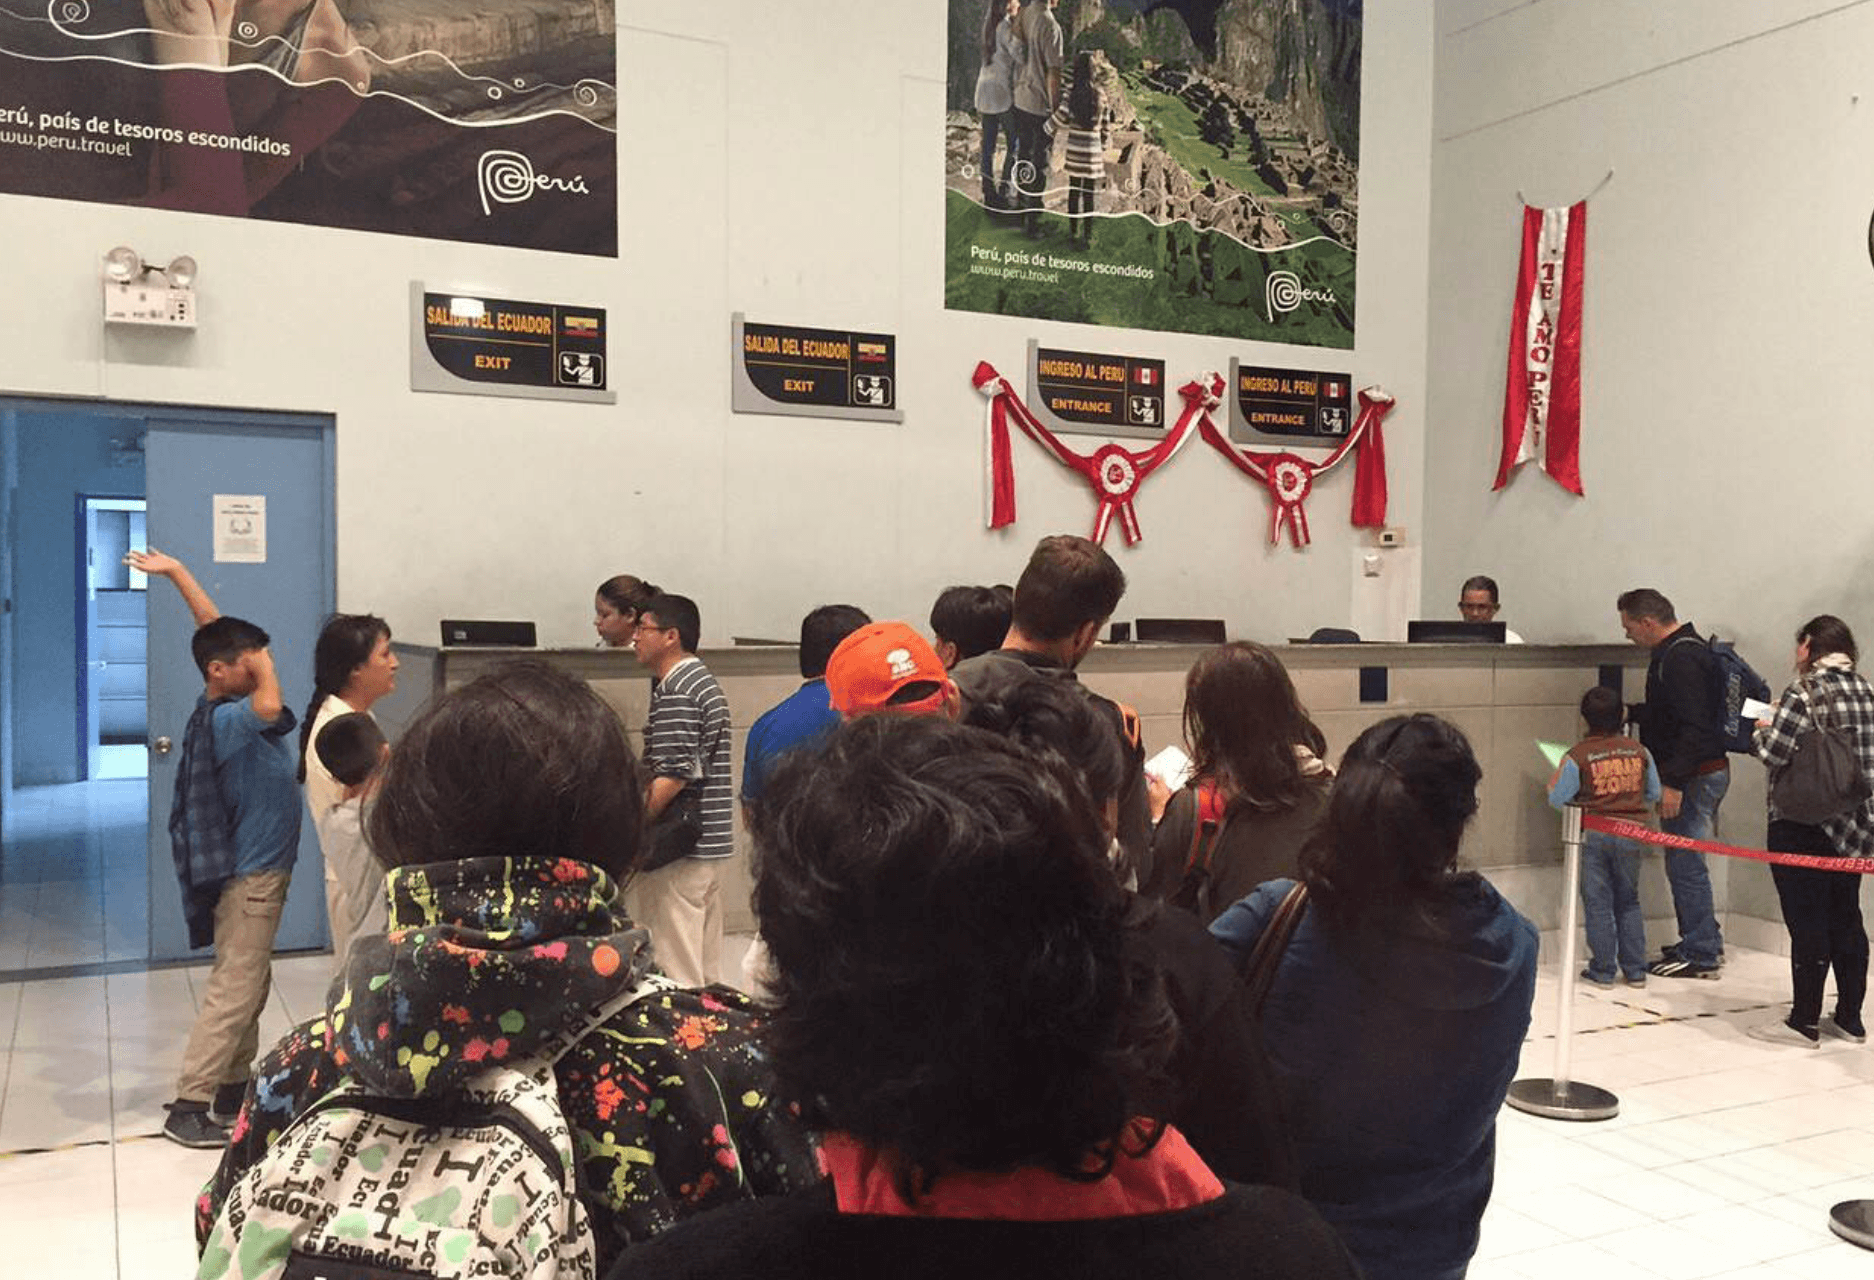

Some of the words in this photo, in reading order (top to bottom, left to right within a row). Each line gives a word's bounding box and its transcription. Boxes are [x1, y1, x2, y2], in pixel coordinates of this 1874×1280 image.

[39, 111, 80, 131] país
[86, 116, 109, 134] de
[114, 118, 183, 143] tesoros
[188, 131, 291, 156] escondidos
[971, 245, 1001, 262] Perú,
[1004, 250, 1029, 265] país
[1031, 253, 1046, 267] de
[1049, 255, 1090, 273] tesoros
[1092, 262, 1154, 280] escondidos
[970, 265, 1059, 284] www.peru.travel
[497, 313, 552, 335] ECUADOR
[745, 334, 780, 354] SALIDA
[782, 338, 801, 356] DEL
[802, 340, 850, 360] ECUADOR
[474, 354, 512, 371] EXIT
[1040, 359, 1083, 378] INGRESO
[1085, 363, 1098, 380] AL
[784, 379, 815, 393] EXIT
[1241, 376, 1279, 392] INGRESO
[1281, 379, 1292, 394] AL
[1052, 397, 1112, 413] ENTRANCE
[1251, 411, 1306, 426] ENTRANCE
